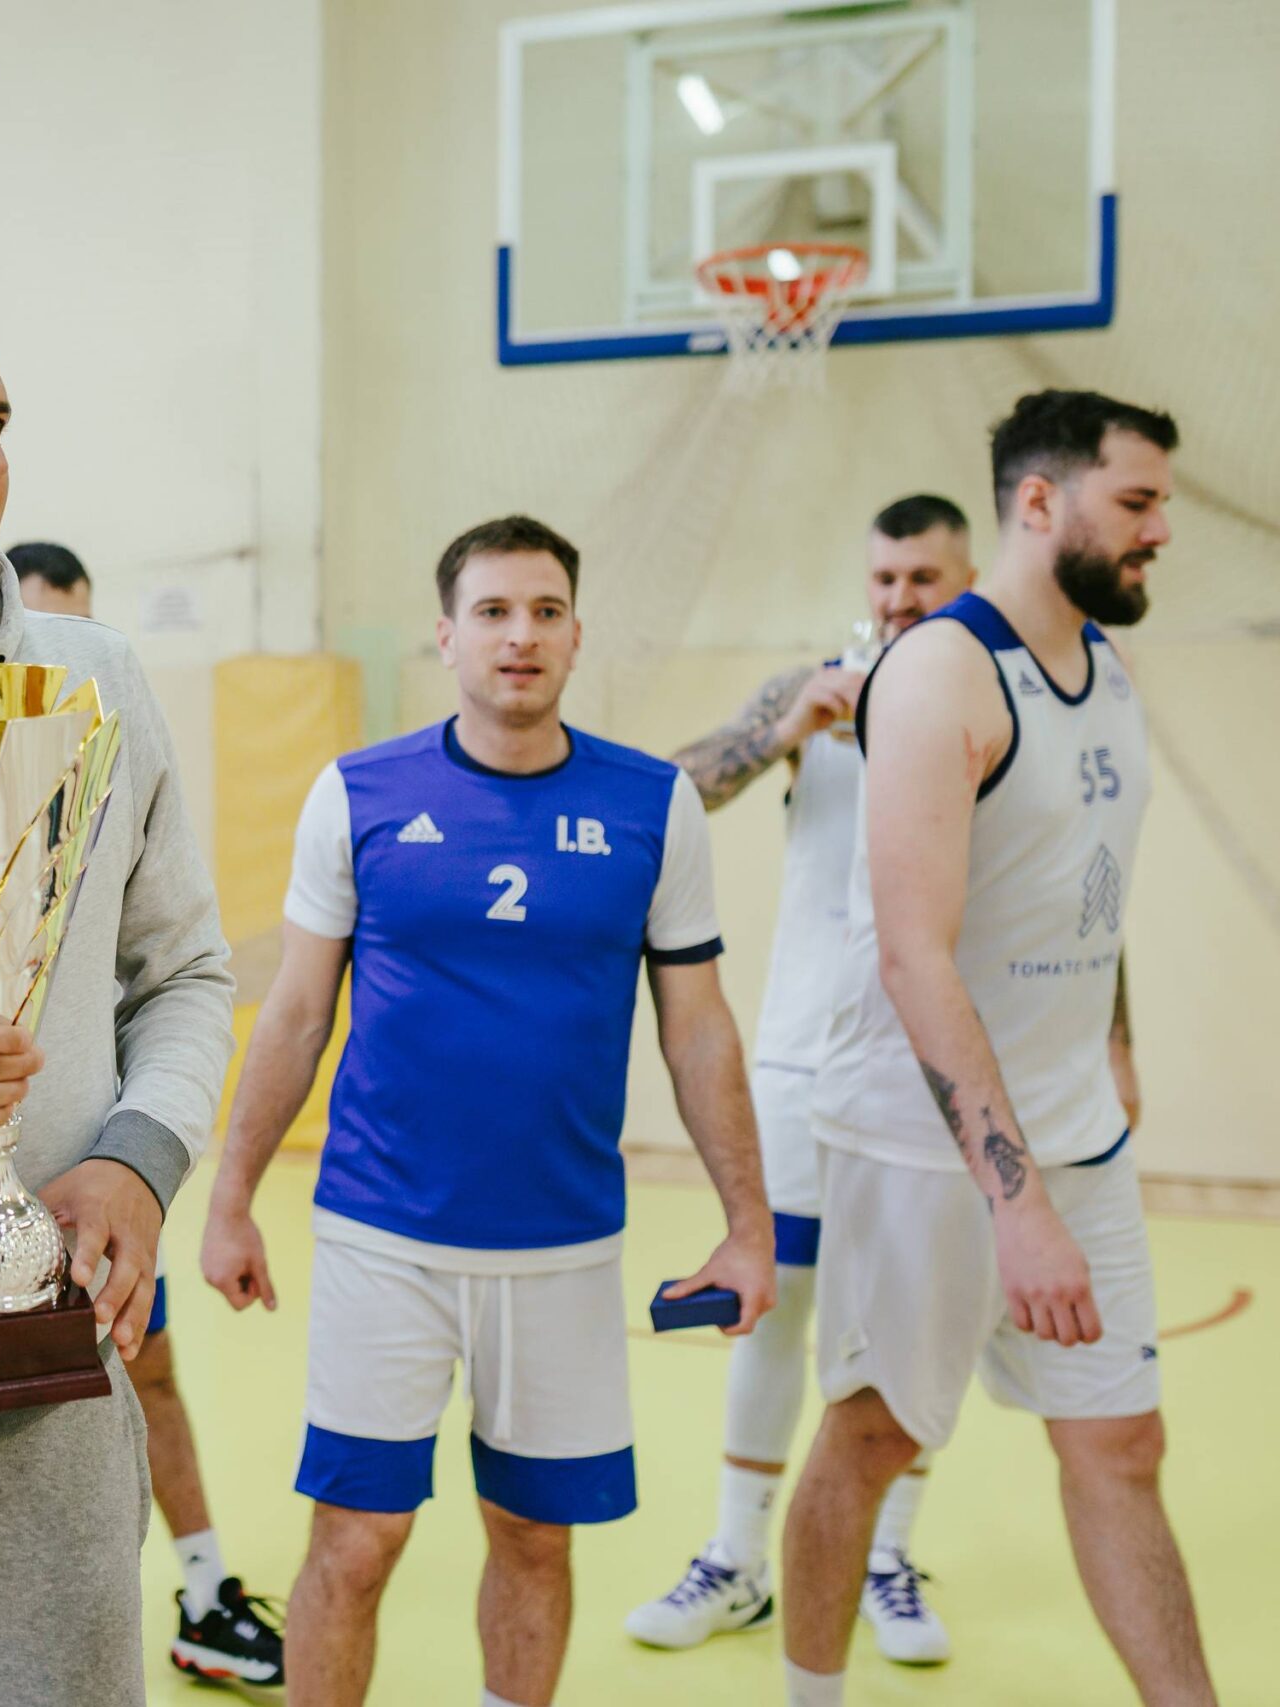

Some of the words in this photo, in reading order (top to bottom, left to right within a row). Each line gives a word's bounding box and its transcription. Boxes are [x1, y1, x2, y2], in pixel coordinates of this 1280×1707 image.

[1080, 747, 1121, 804] 55
[555, 814, 612, 856] I.B.
[486, 863, 529, 922] 2
